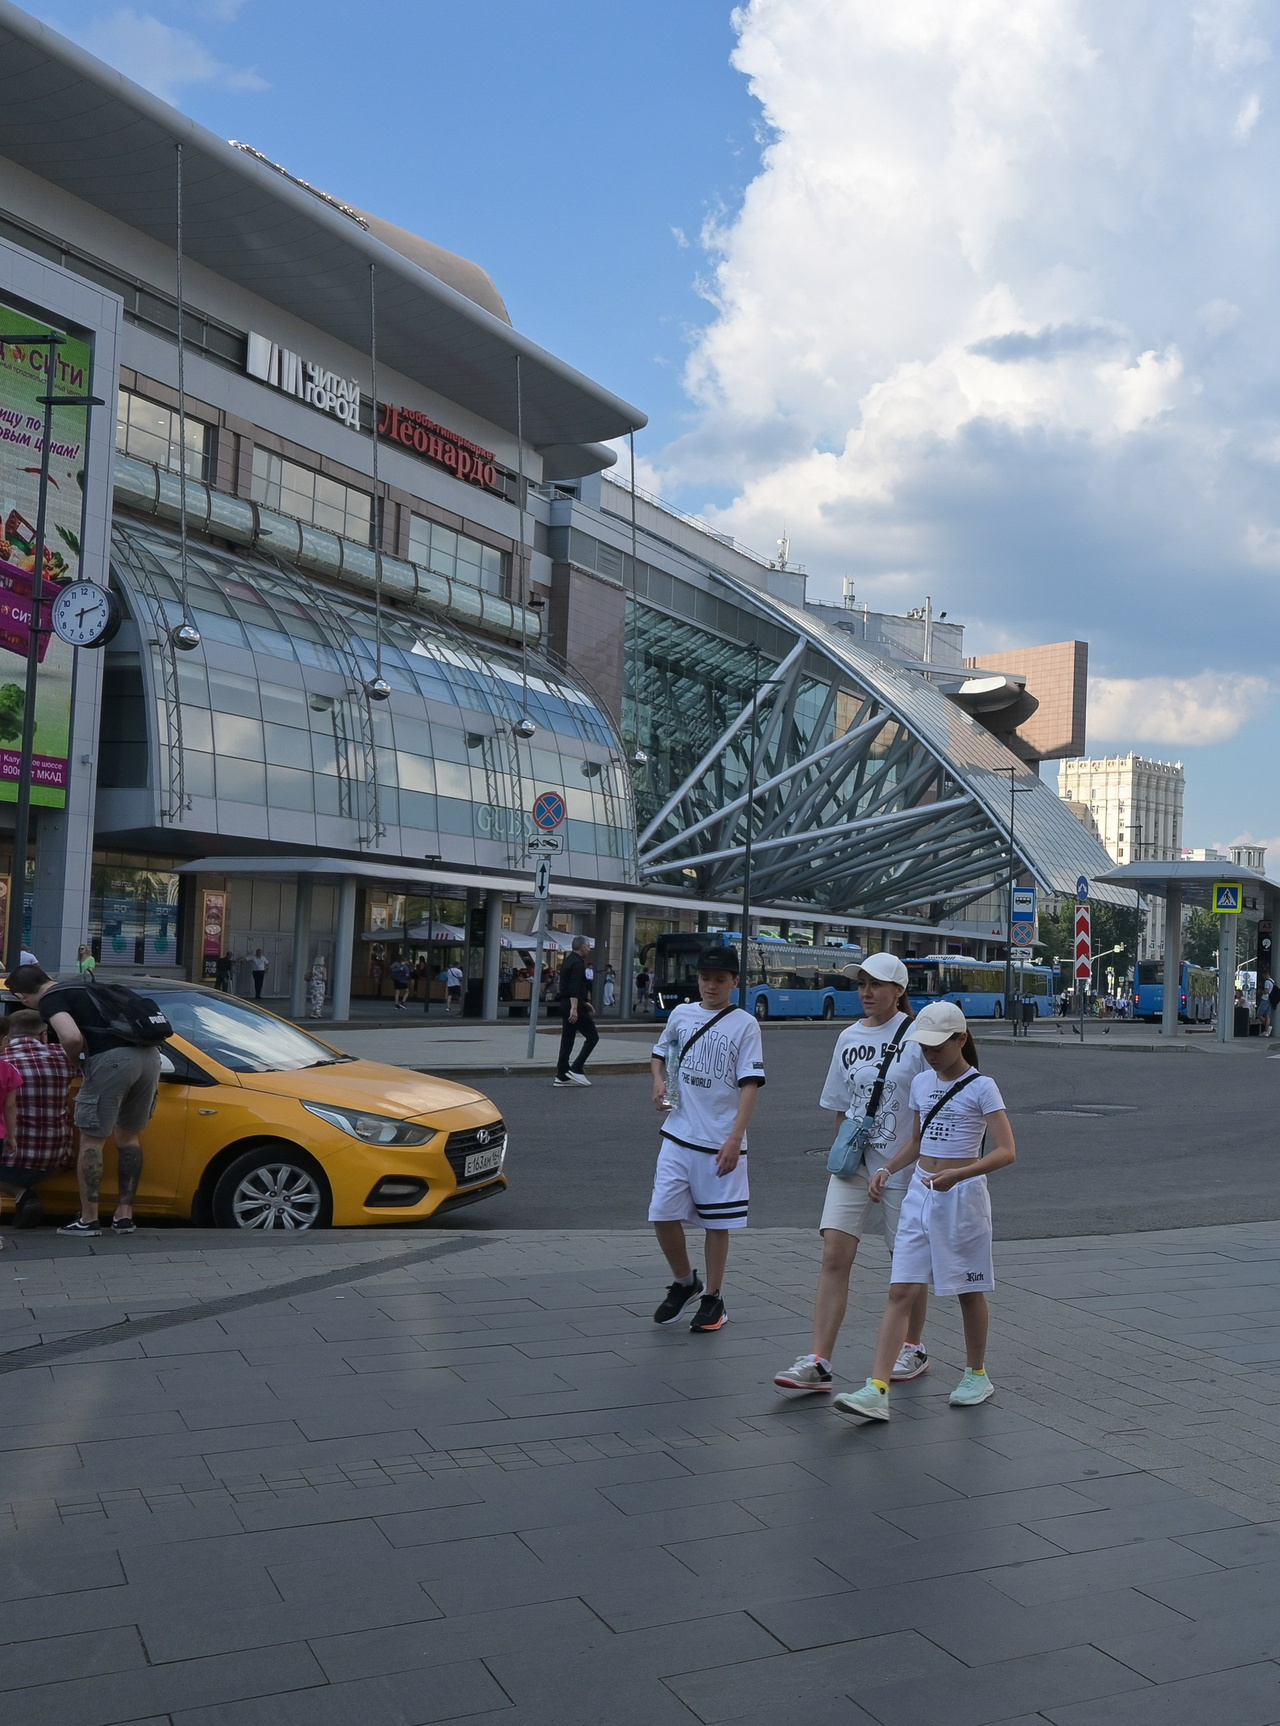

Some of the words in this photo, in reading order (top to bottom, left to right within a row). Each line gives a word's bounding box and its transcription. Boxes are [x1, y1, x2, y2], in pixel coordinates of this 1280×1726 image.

[306, 361, 360, 404] ЧИТАЙ
[0, 408, 23, 427] ицу
[305, 381, 360, 431] ГОРОД
[0, 426, 32, 447] овым
[34, 439, 80, 459] цнам!
[378, 403, 498, 488] Леонардо
[401, 406, 497, 461] хобби-гипермаркет
[36, 770, 62, 783] МКАД
[478, 805, 542, 838] GUES
[841, 1045, 876, 1070] GOOD
[881, 1042, 907, 1063] BY
[682, 1072, 691, 1085] THE
[691, 1076, 712, 1089] WORLD
[965, 1272, 984, 1283] Rich
